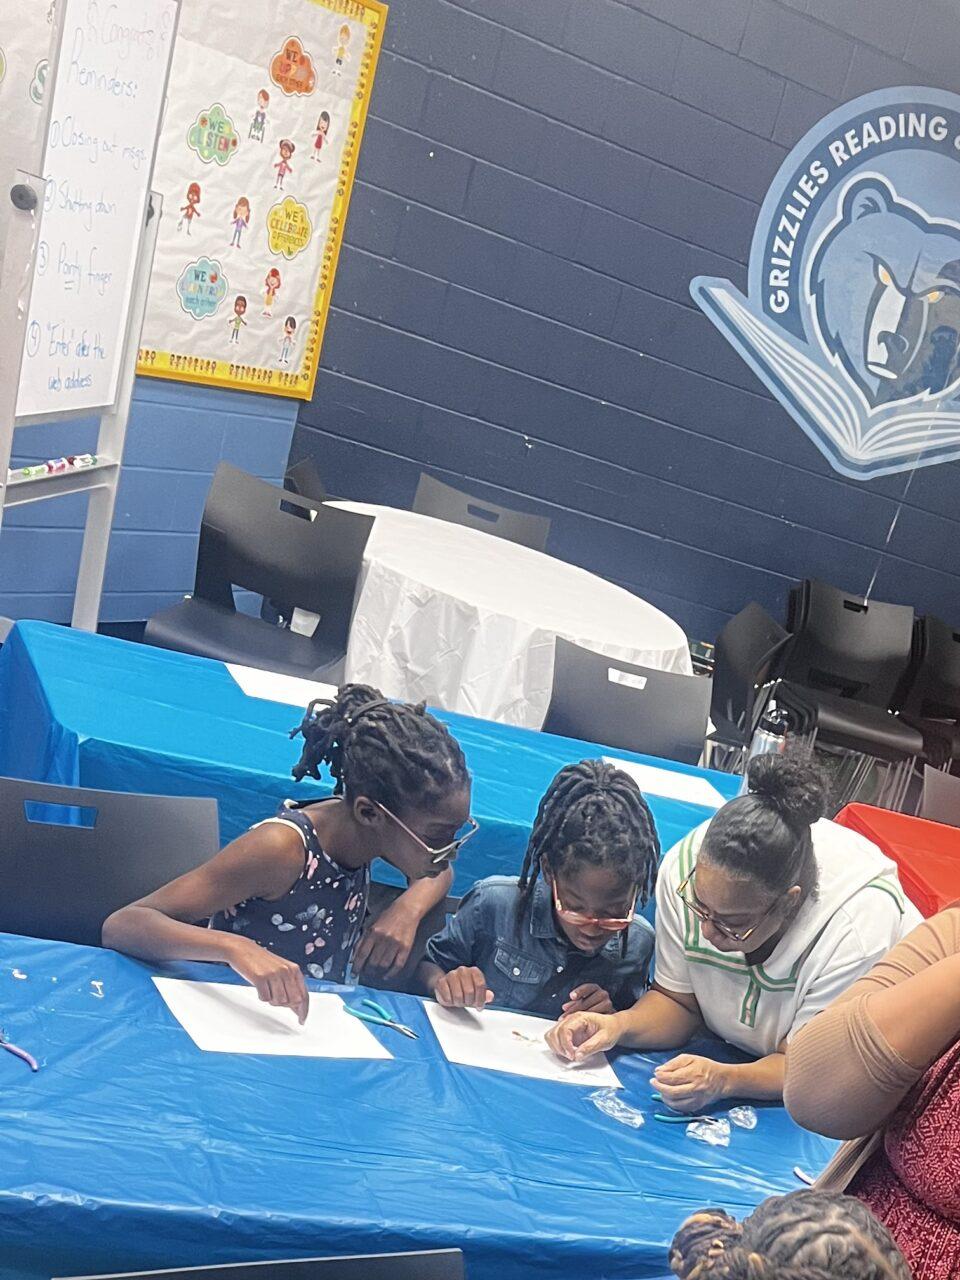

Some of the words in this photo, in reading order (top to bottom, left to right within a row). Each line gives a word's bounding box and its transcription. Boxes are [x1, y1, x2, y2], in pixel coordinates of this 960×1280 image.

[208, 118, 225, 134] WE
[284, 209, 299, 223] WE
[768, 159, 830, 314] GRIZZLIES
[827, 112, 949, 168] READING
[193, 268, 207, 282] WE
